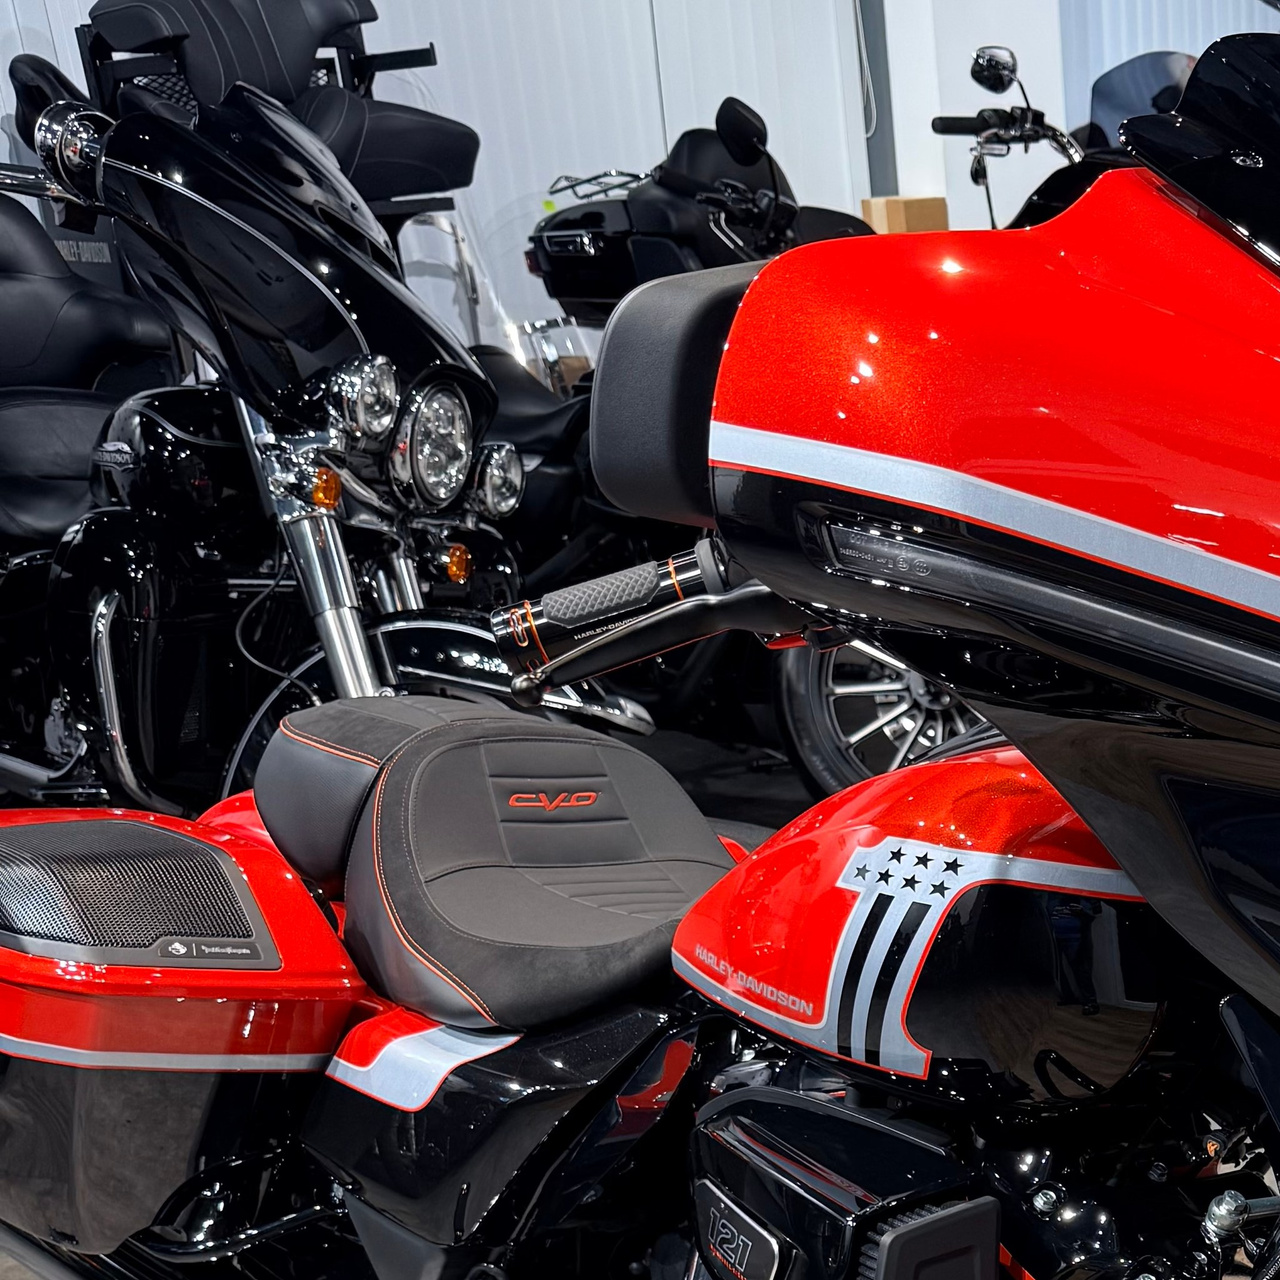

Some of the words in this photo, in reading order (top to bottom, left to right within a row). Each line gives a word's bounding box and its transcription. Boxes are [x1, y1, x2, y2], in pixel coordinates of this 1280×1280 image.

[508, 791, 598, 811] CVO
[695, 944, 813, 1016] HARLEY-DAVIDSON
[708, 1206, 753, 1272] 121
